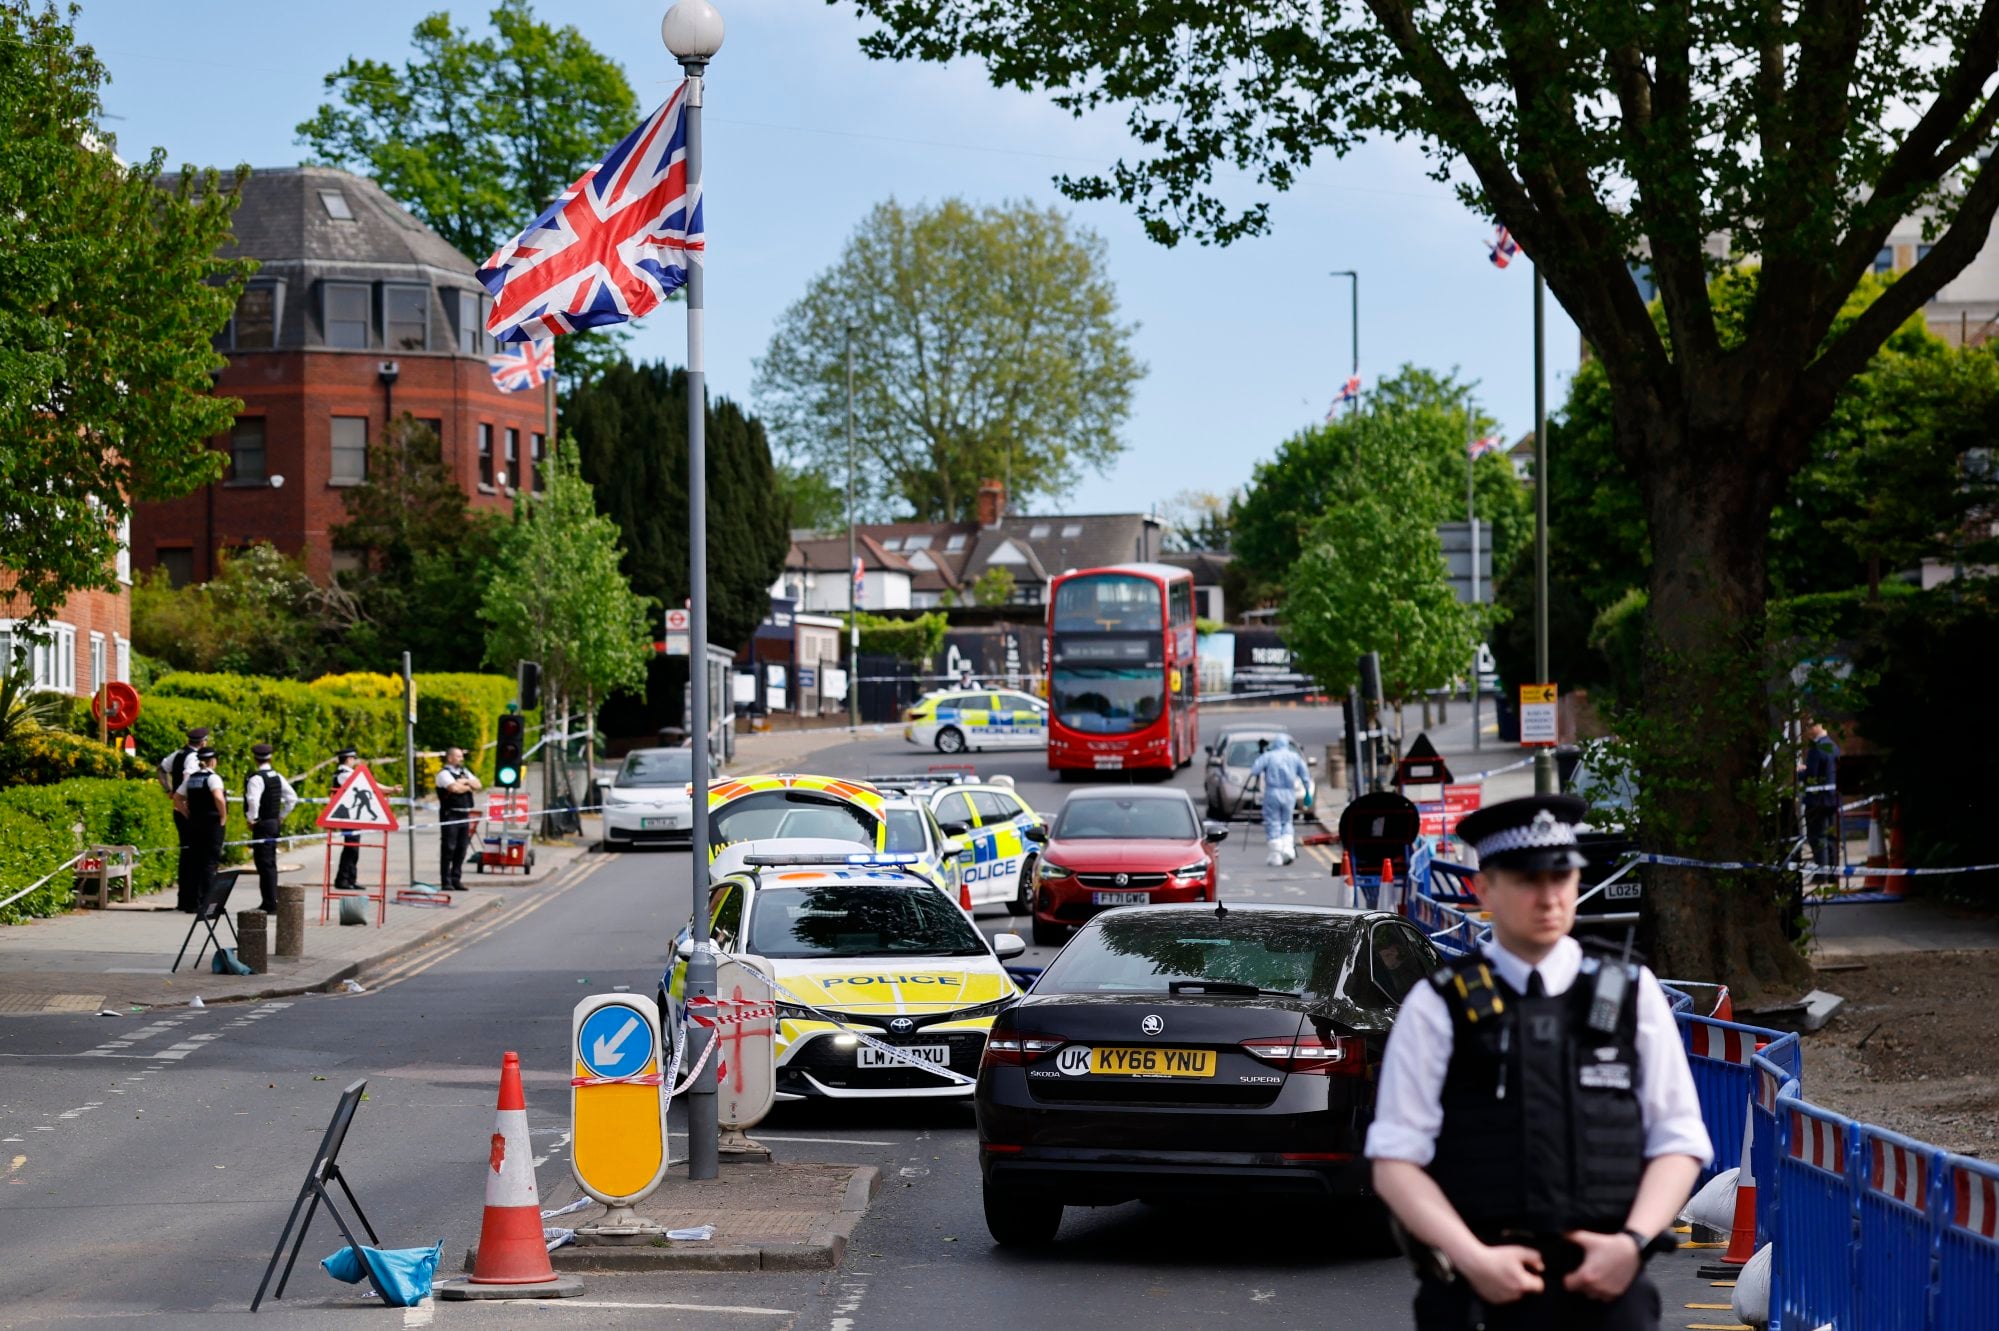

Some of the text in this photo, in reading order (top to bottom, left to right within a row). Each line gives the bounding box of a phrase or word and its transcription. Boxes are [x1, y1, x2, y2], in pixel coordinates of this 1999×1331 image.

[964, 860, 1017, 883] OLICE
[822, 975, 960, 989] POLICE
[1061, 1050, 1090, 1070] UK
[1100, 1050, 1206, 1072] KY66 YNU
